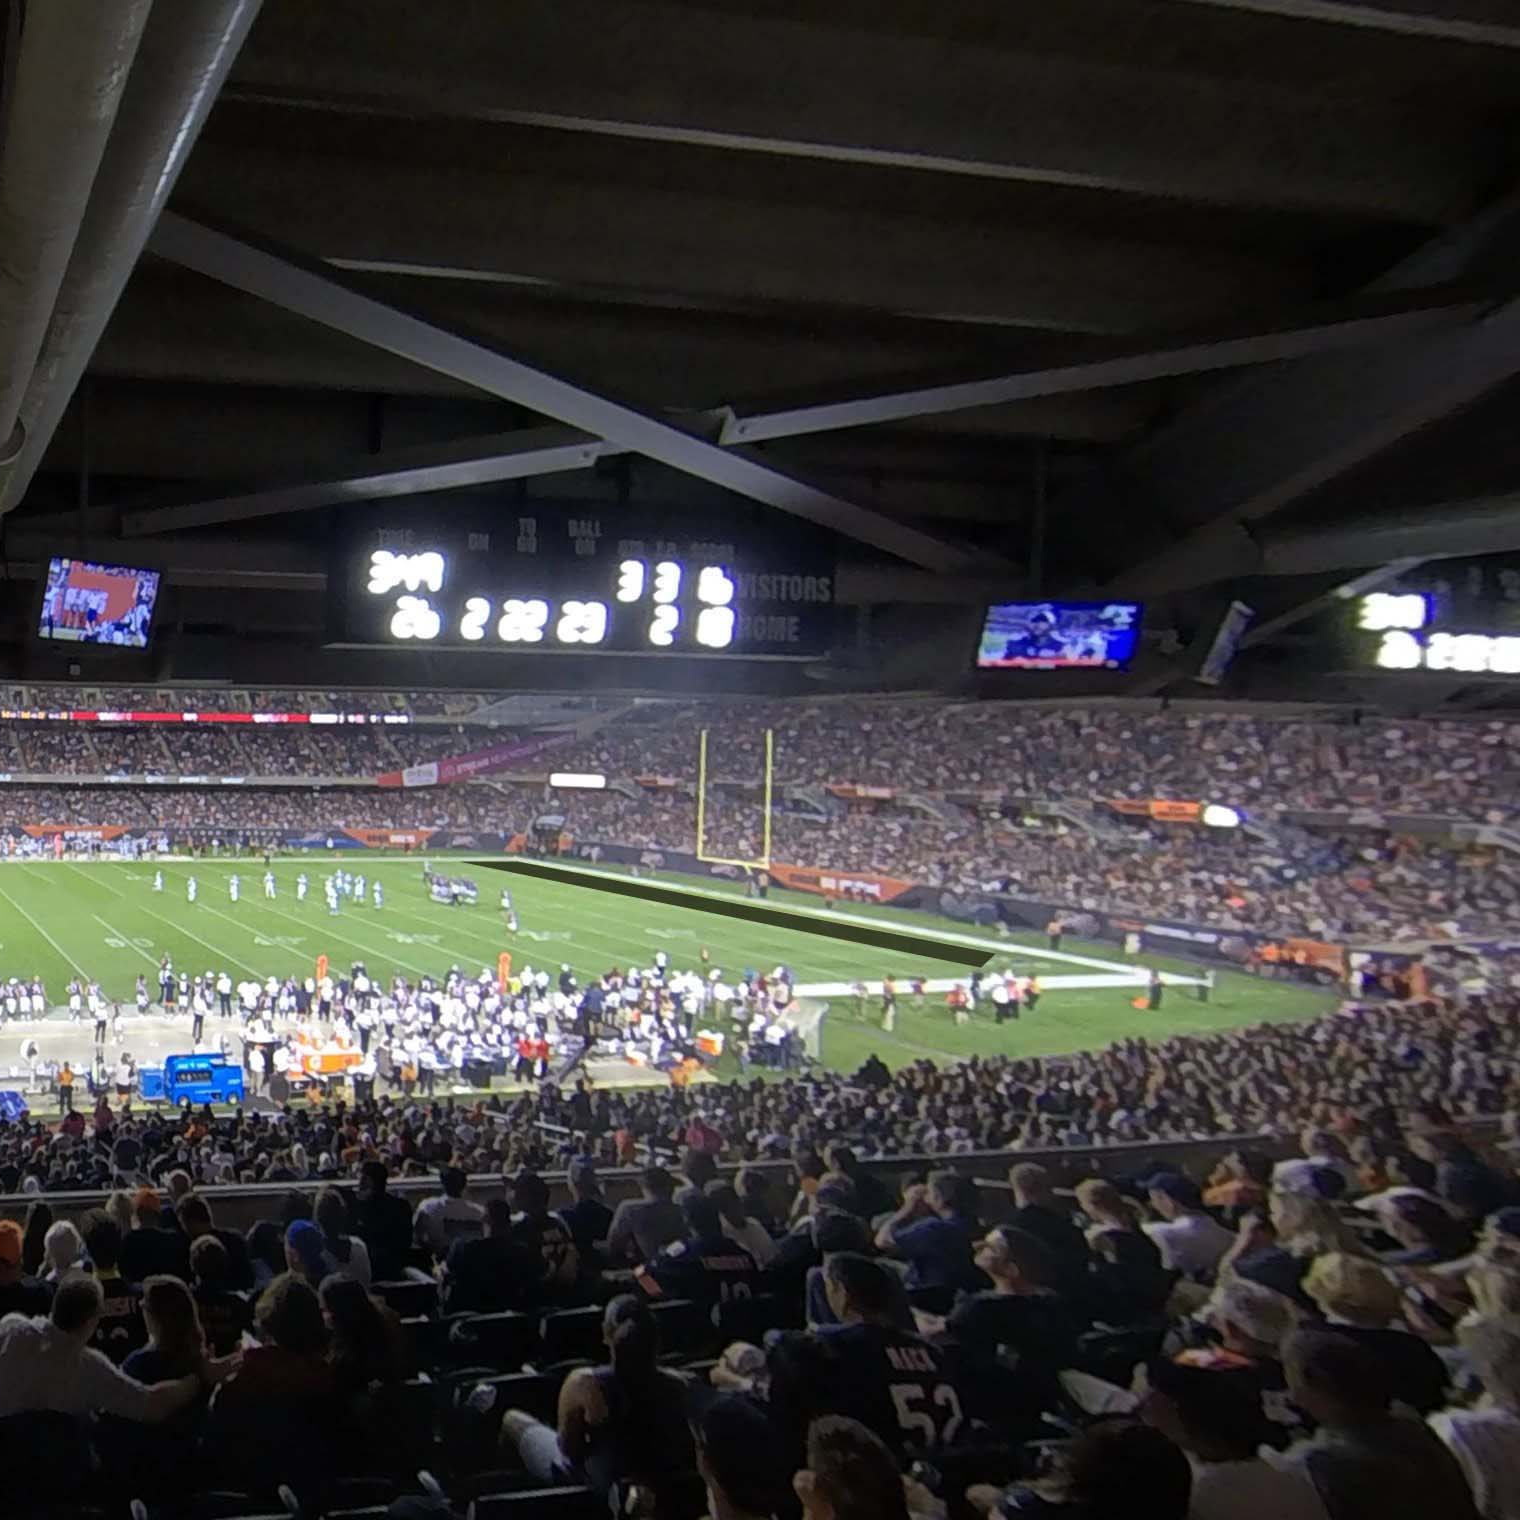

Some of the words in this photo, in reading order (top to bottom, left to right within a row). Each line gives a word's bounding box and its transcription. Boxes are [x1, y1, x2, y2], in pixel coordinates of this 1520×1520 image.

[567, 519, 601, 537] BALL
[618, 561, 643, 601] 3
[654, 563, 679, 602] 3
[737, 570, 831, 602] VISITORS
[460, 597, 490, 639] 2
[499, 600, 547, 641] 22
[650, 605, 678, 644] 2
[737, 613, 800, 642] HOME
[885, 1346, 937, 1373] MACK
[888, 1384, 963, 1443] 52
